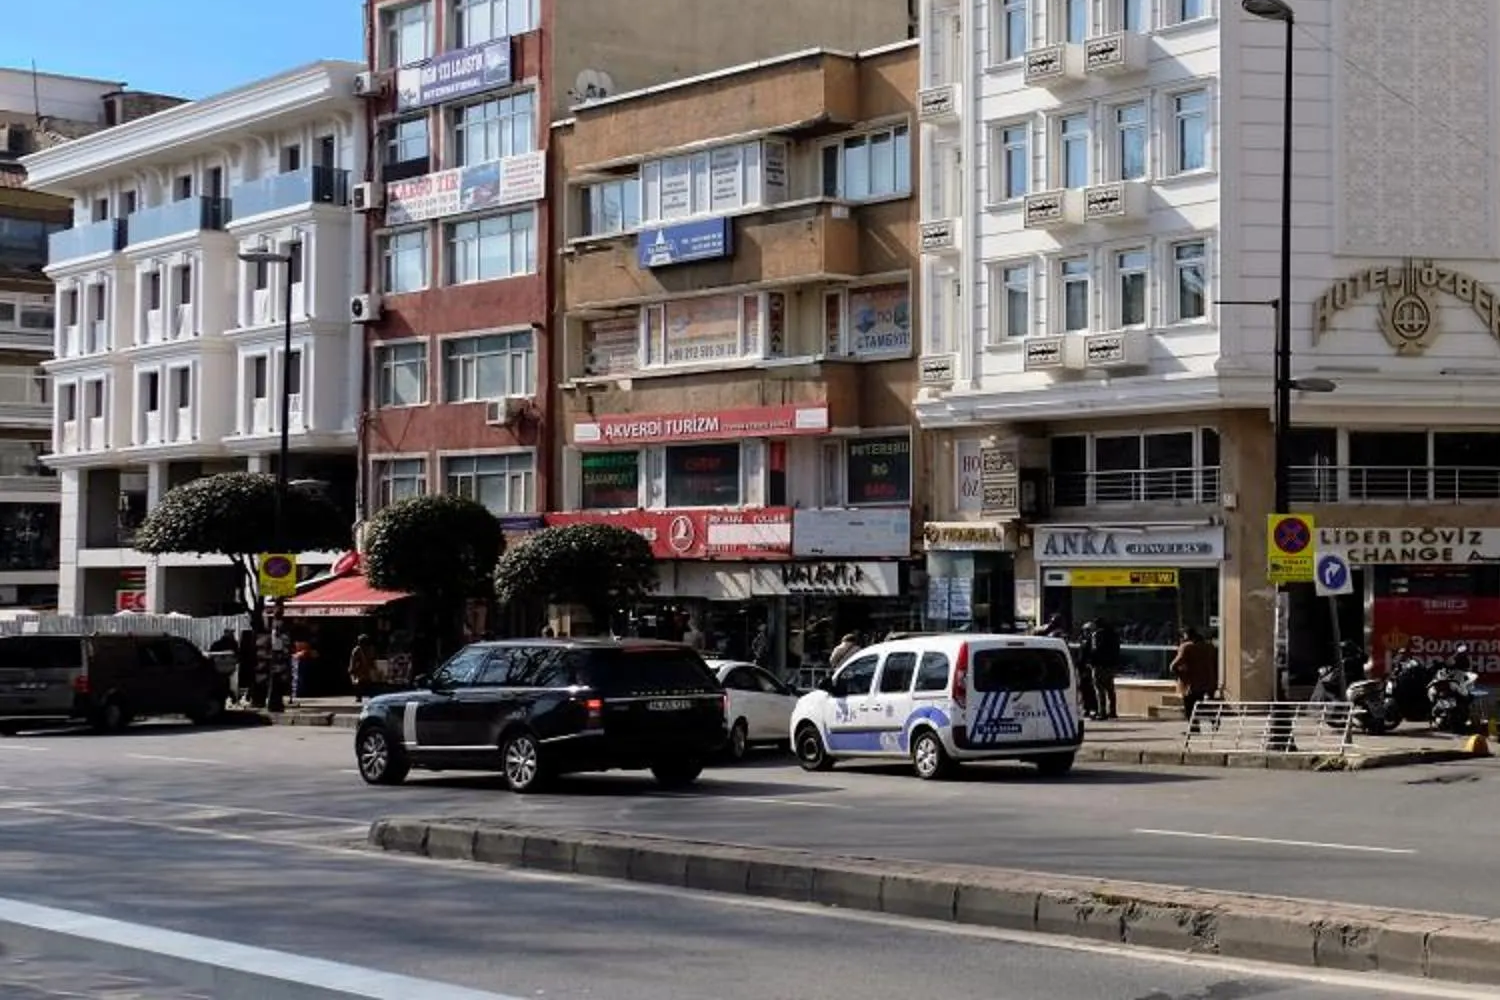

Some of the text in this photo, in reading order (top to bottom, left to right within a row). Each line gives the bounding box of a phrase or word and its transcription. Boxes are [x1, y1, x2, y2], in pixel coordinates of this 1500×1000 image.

[1311, 265, 1402, 347] HOTEL
[604, 421, 662, 439] AKVERDİ
[666, 412, 720, 435] TURİZM
[1043, 533, 1118, 556] ANKA
[1320, 527, 1484, 546] LİDER DÖVİZ
[1348, 547, 1453, 562] CHANGE
